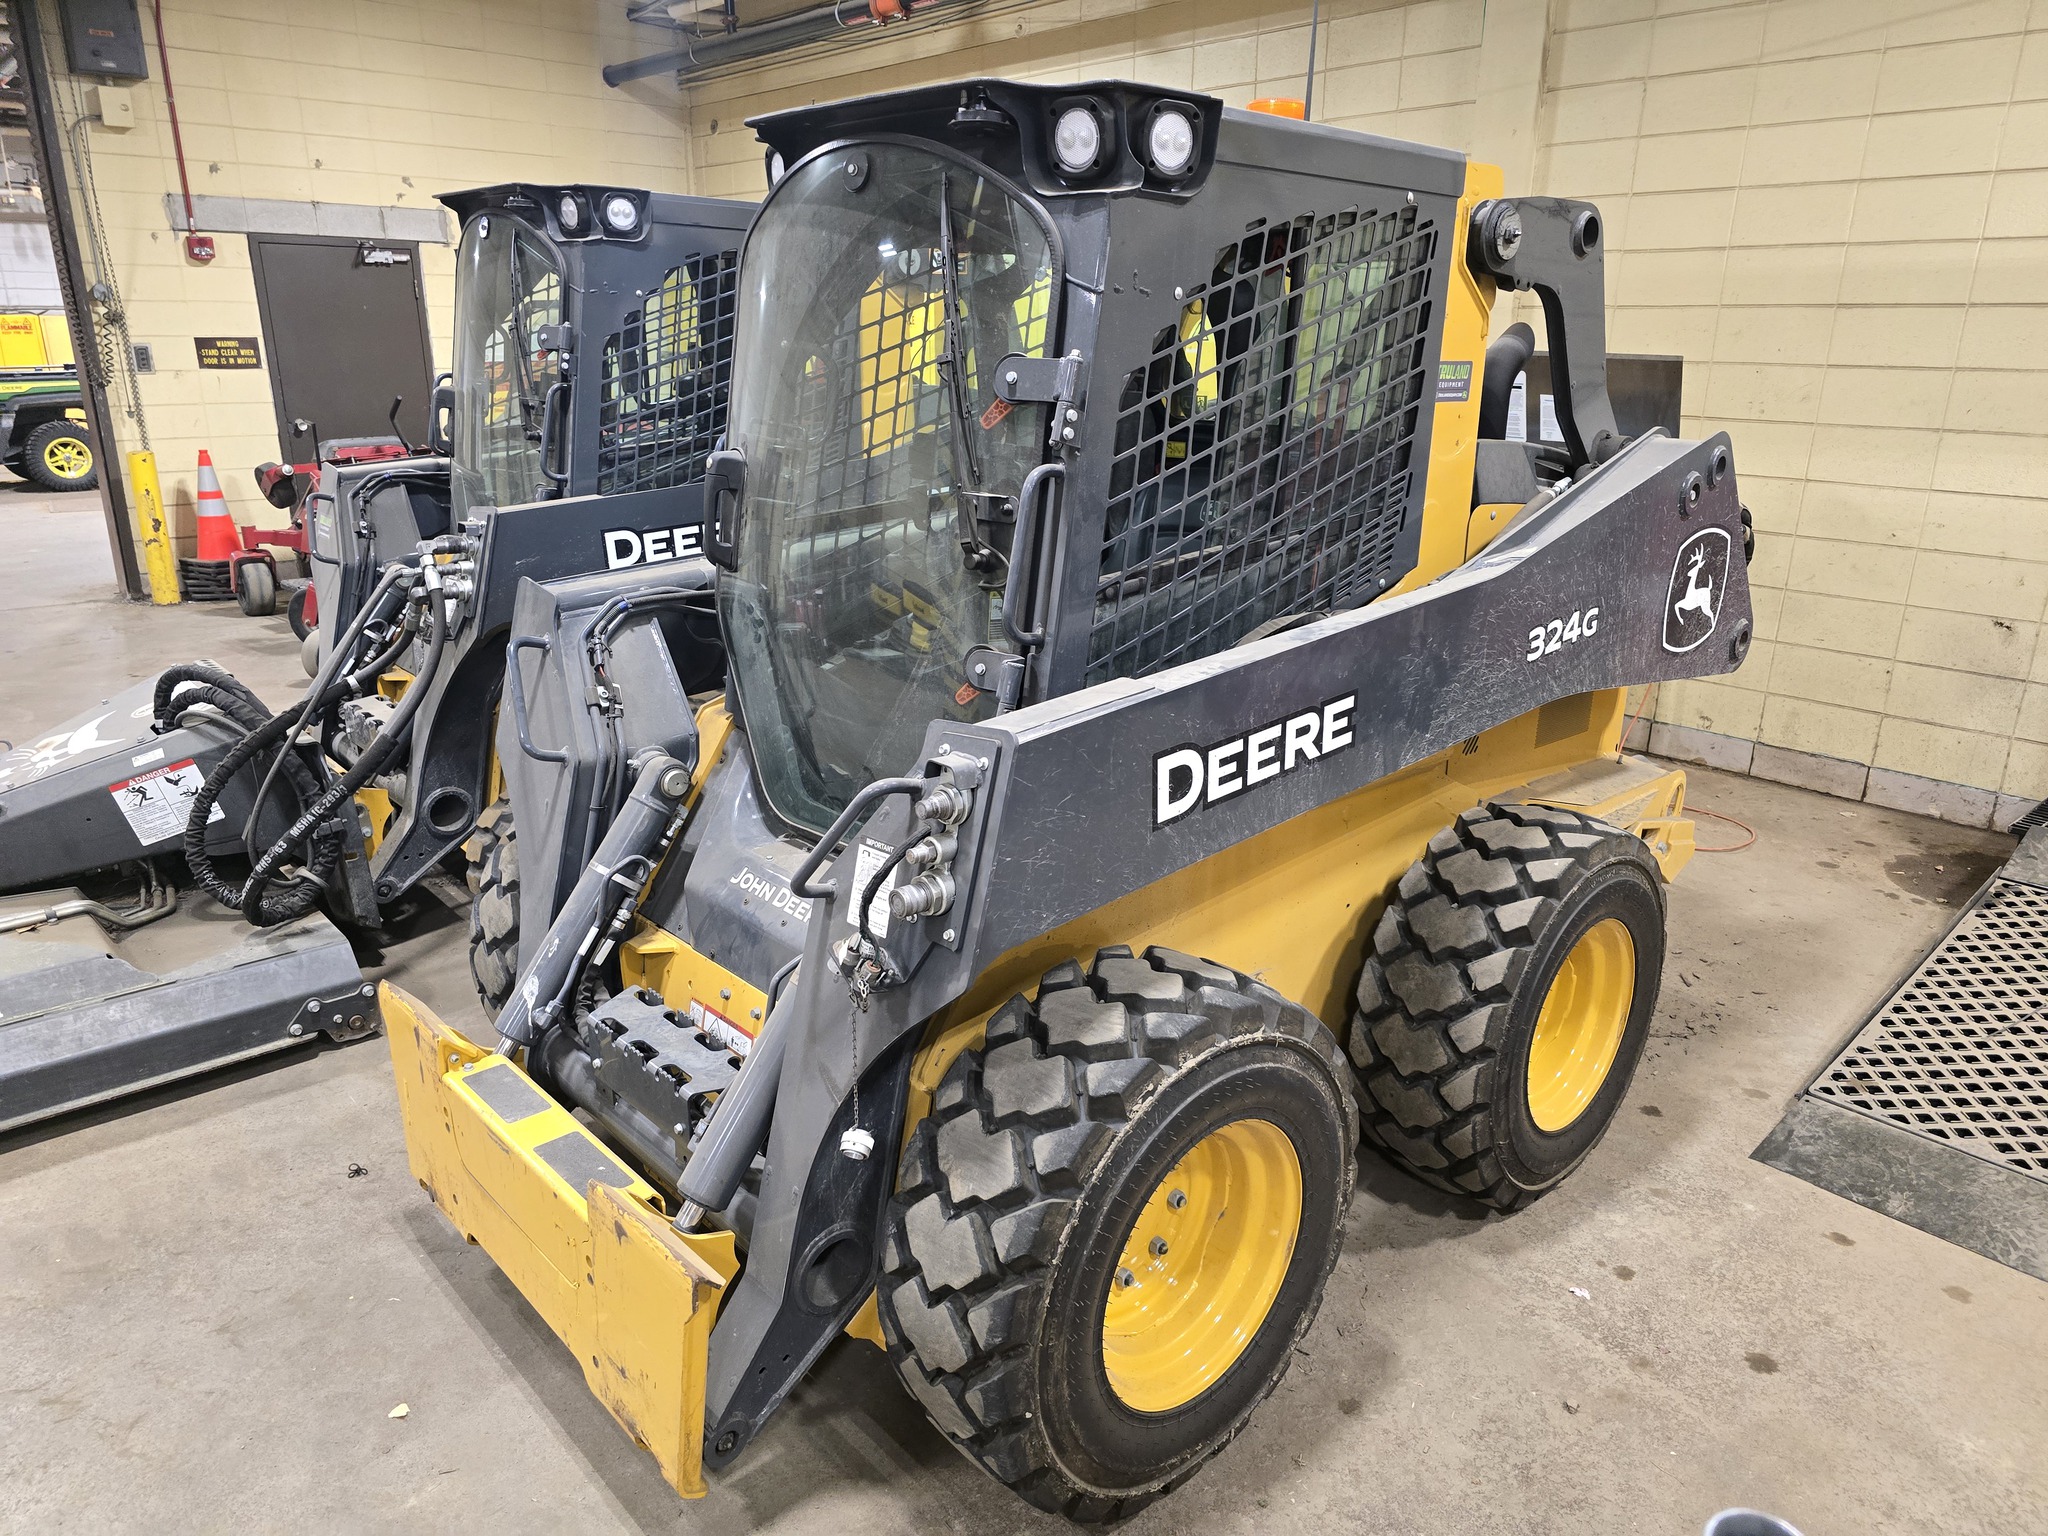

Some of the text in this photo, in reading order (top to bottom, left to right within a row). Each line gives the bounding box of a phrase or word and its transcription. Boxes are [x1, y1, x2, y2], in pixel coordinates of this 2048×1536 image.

[1526, 607, 1600, 663] 324G
[134, 766, 172, 784] DANGER
[1157, 695, 1355, 824] DEERE
[289, 813, 316, 838] MSHA
[311, 784, 348, 818] IC-293/1
[865, 837, 895, 854] IMPORTANT
[729, 866, 777, 902] JOHN
